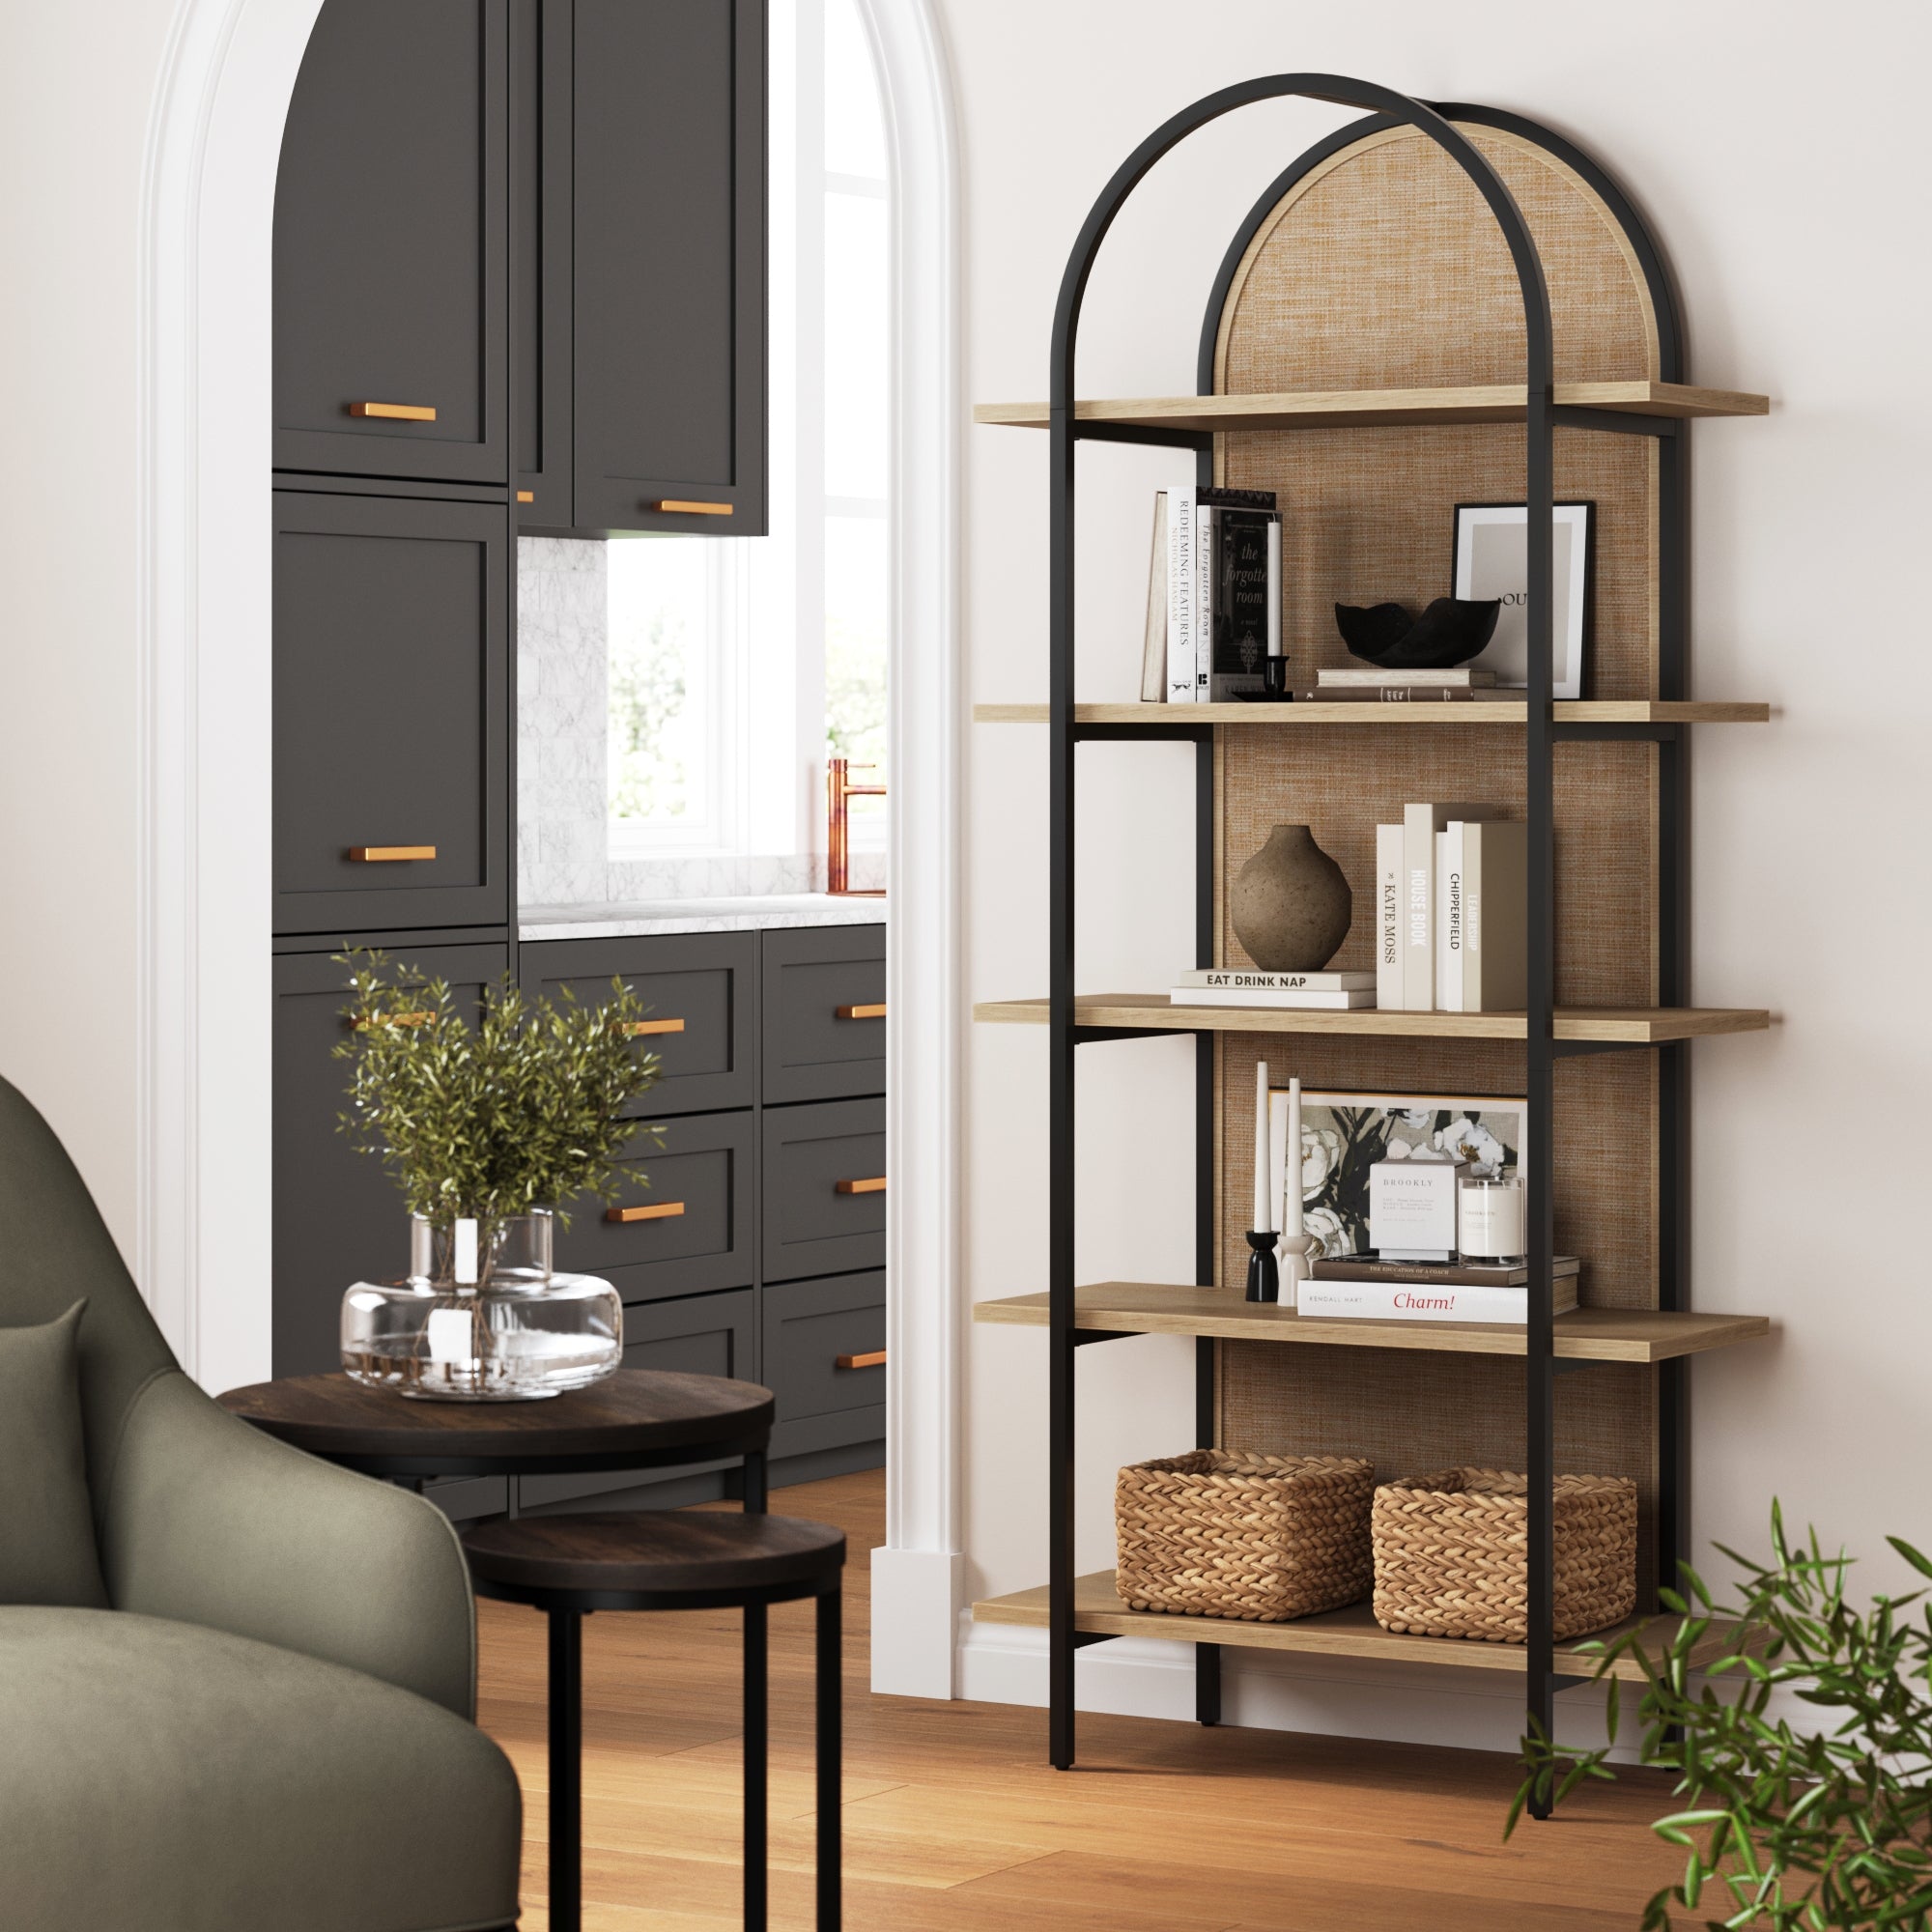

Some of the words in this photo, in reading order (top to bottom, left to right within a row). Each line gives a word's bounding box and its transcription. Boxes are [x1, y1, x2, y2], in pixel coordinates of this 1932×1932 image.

[1179, 500, 1189, 577] REDEEMING
[1241, 543, 1258, 560] the
[1202, 548, 1210, 602] Forgotten
[1222, 563, 1268, 587] forgotte
[1179, 582, 1189, 646] FEATURES
[1236, 590, 1264, 605] room
[1202, 607, 1210, 636] Room
[1384, 884, 1396, 922] KATE
[1410, 869, 1427, 910] HOUSE
[1410, 913, 1427, 947] BOOK
[1450, 872, 1460, 951] CHIPPERFIELD
[1467, 895, 1478, 952] LEADERSHIP
[1384, 925, 1396, 964] MOSS
[1207, 974, 1231, 986] EAT
[1234, 975, 1276, 987] DRINK
[1279, 976, 1307, 988] NAP
[1393, 1293, 1456, 1311] Charm!
